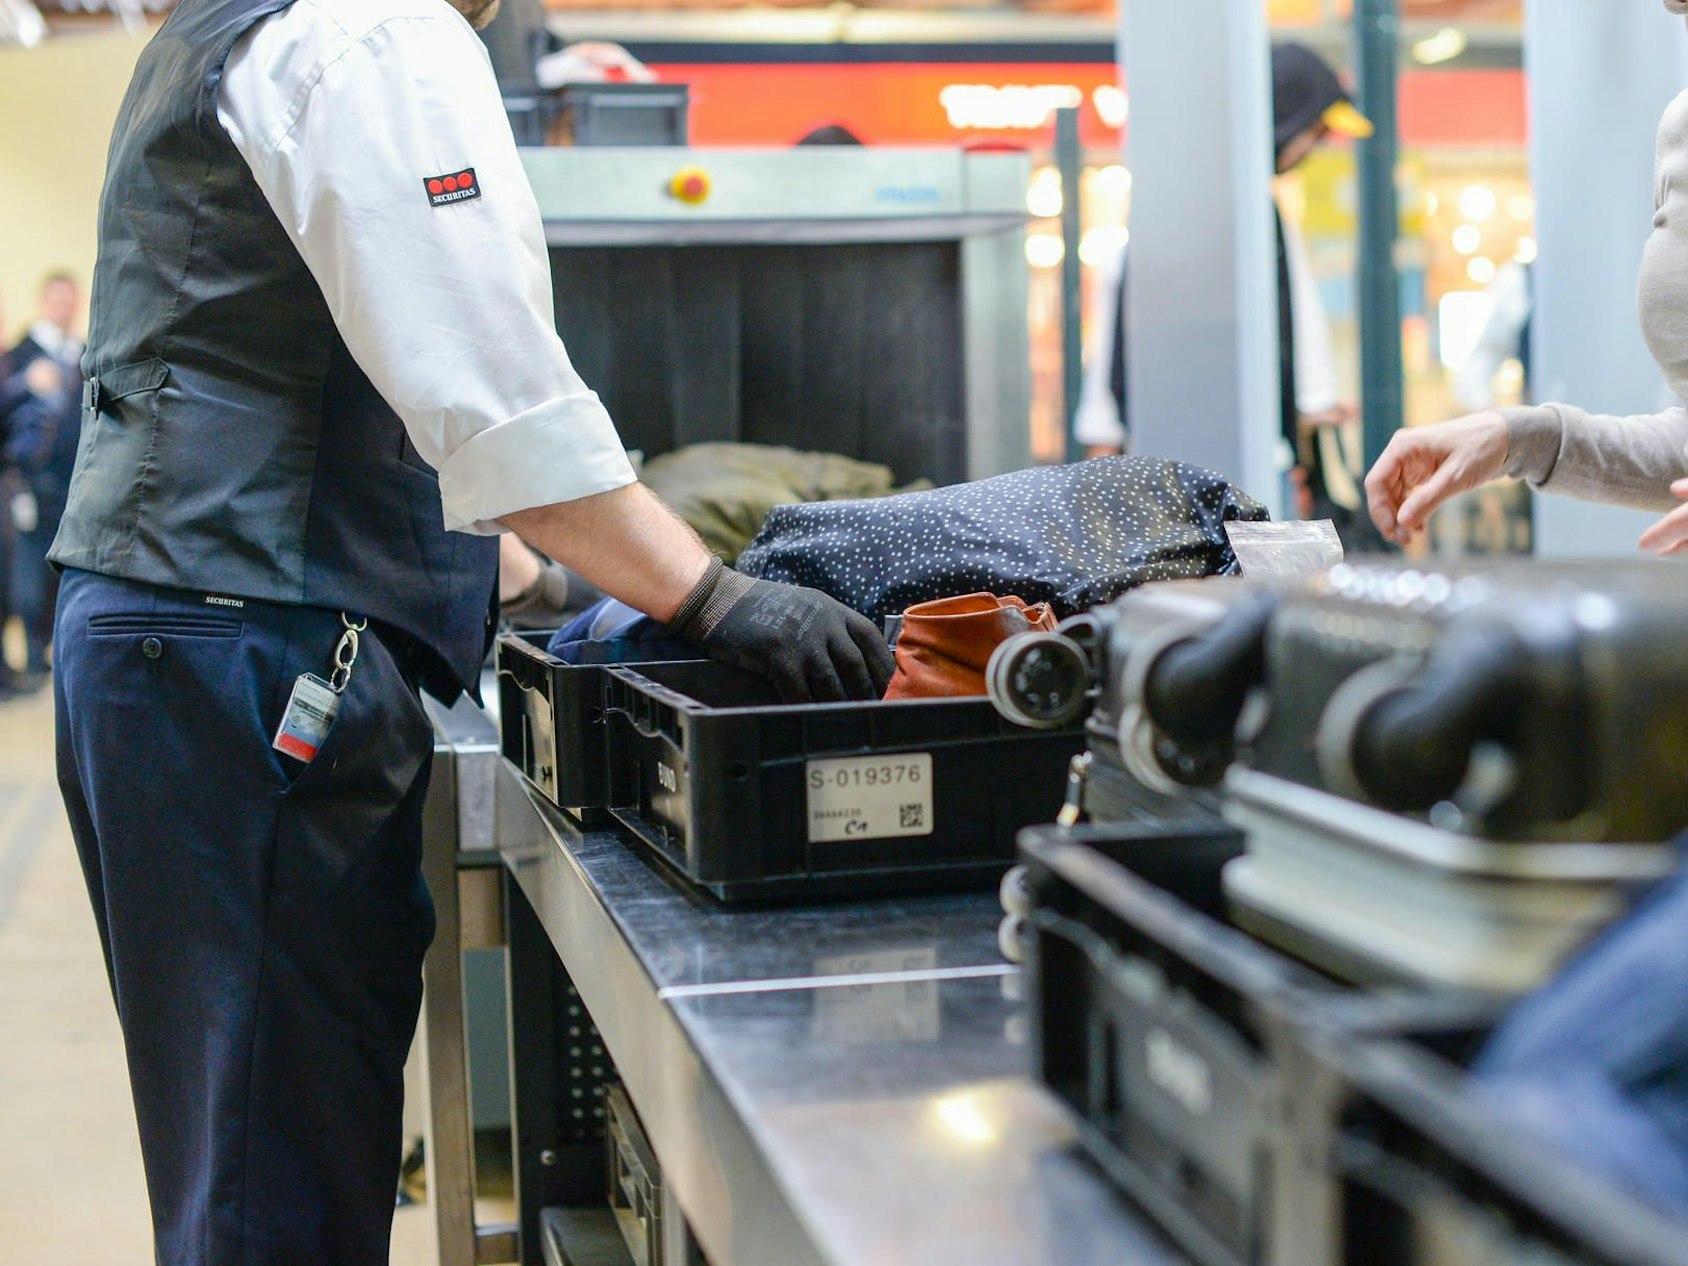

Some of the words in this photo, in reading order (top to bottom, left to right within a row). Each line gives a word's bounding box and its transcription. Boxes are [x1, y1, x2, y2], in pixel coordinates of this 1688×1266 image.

[433, 188, 476, 203] SECURITAS
[205, 596, 244, 607] SECURITAS
[810, 765, 921, 790] S-019376
